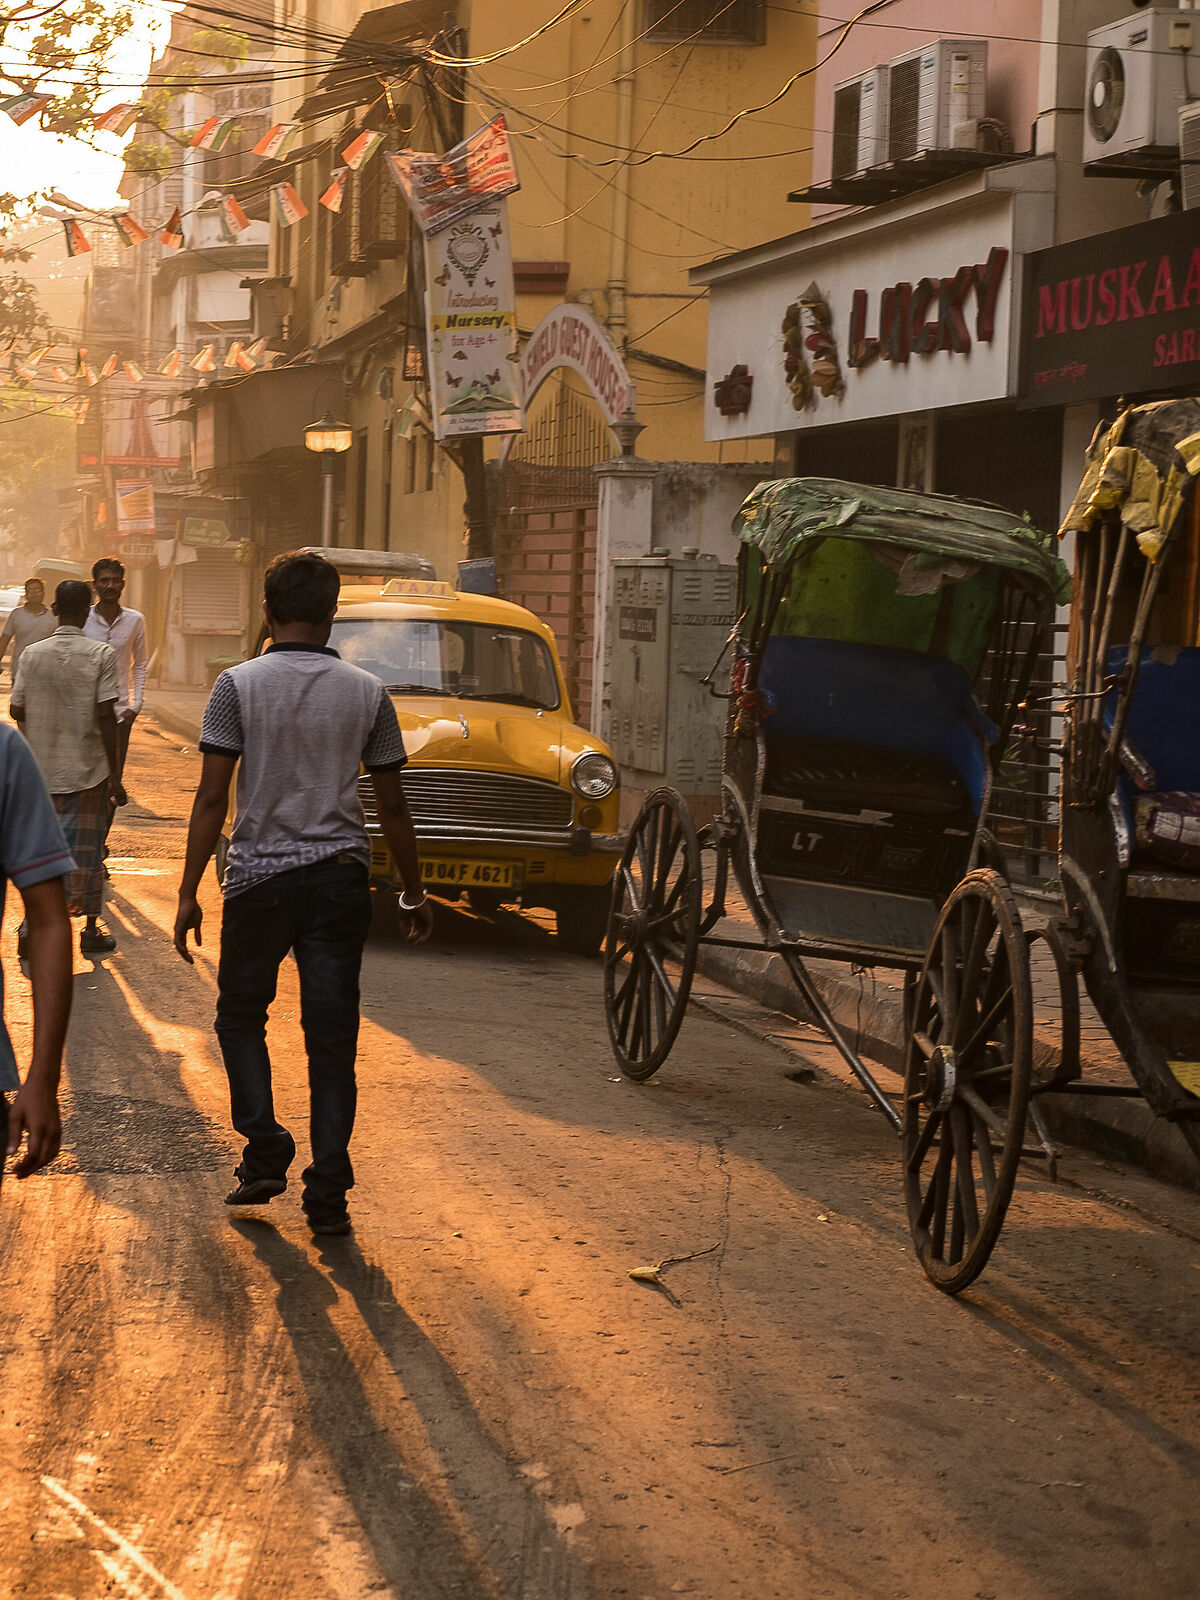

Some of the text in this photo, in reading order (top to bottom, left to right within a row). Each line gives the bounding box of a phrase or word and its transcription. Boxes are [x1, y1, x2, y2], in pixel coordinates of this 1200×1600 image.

[447, 289, 498, 311] Introducing
[848, 247, 1008, 367] LUCKY
[560, 316, 591, 366] GUEST
[585, 335, 620, 416] HOUSE
[395, 582, 446, 596] TAXI
[791, 831, 824, 851] LT
[473, 865, 510, 883] 4621
